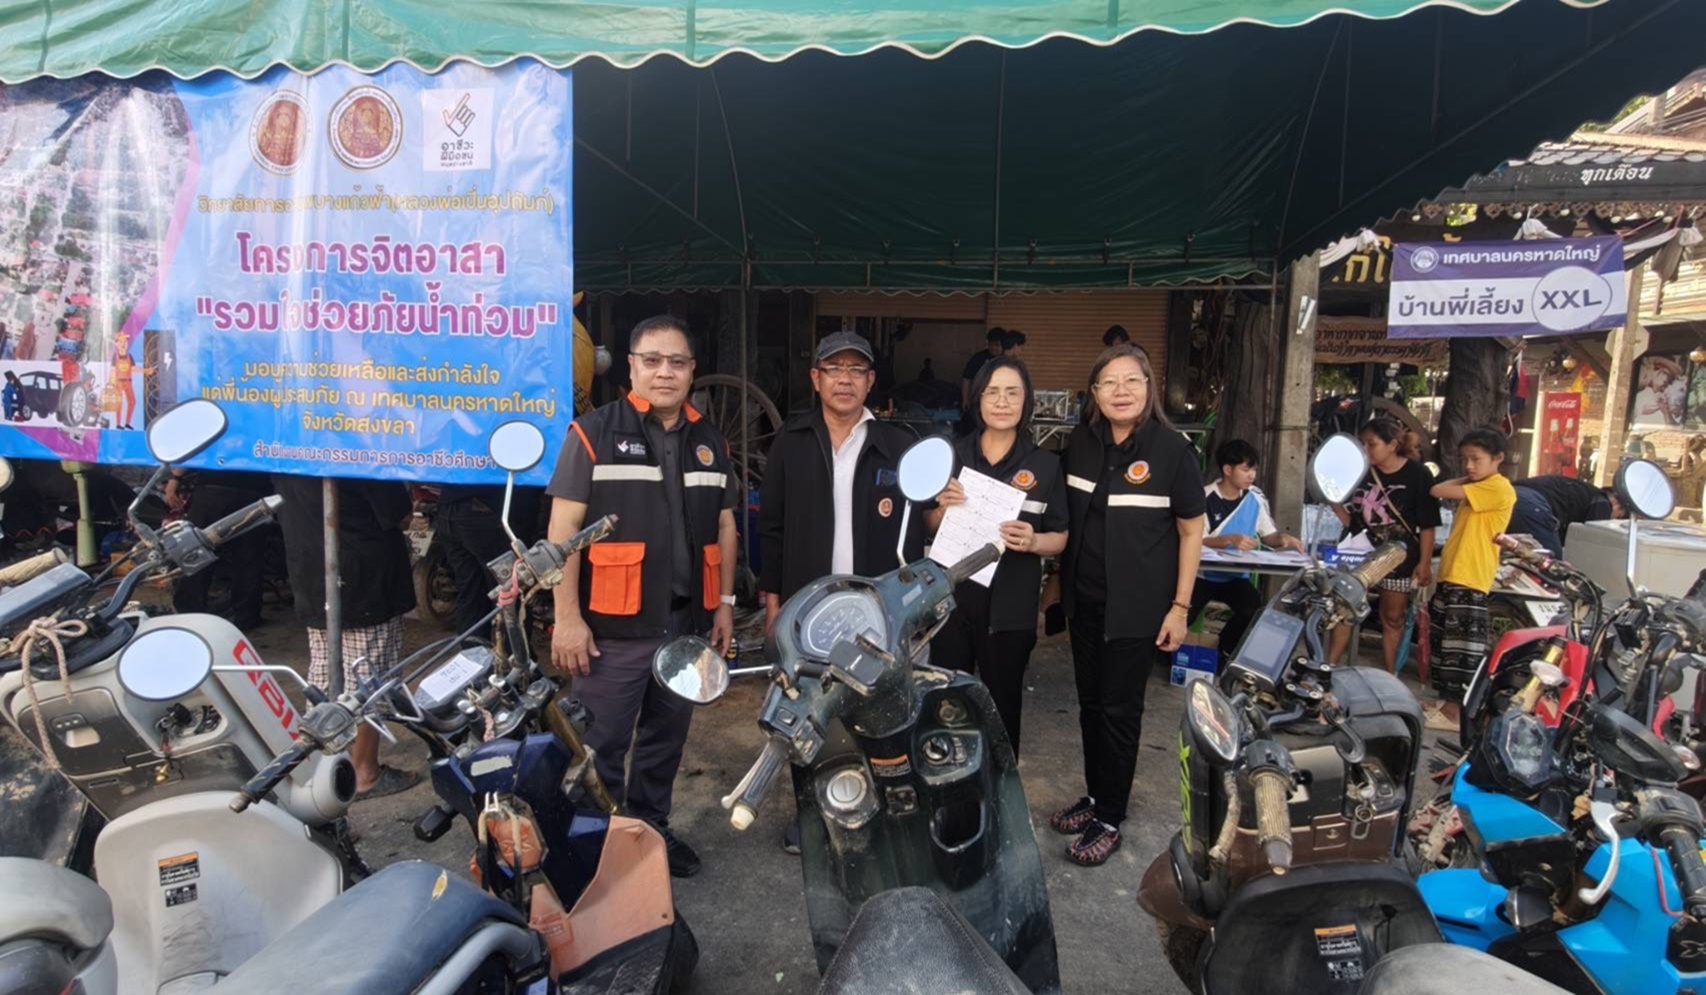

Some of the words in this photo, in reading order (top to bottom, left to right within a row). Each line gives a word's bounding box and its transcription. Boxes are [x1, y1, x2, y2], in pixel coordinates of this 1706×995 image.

[440, 139, 474, 151] อาชีวะ
[1580, 164, 1654, 186] ทุกเดือน
[236, 232, 506, 274] โครงการจิตอาสา
[1443, 245, 1600, 265] เทศบาลนครหาดใหญ่
[196, 281, 557, 337] "รวมใจช่วยภัยน้ำท่วม"
[1399, 286, 1525, 317] บ้านพี่เลี้ยง
[1540, 289, 1604, 311] XXL
[346, 391, 366, 406] ณ
[373, 387, 557, 418] เทศบาลนครหาดใหญ่
[303, 410, 415, 435] จังหวัดสงขลา
